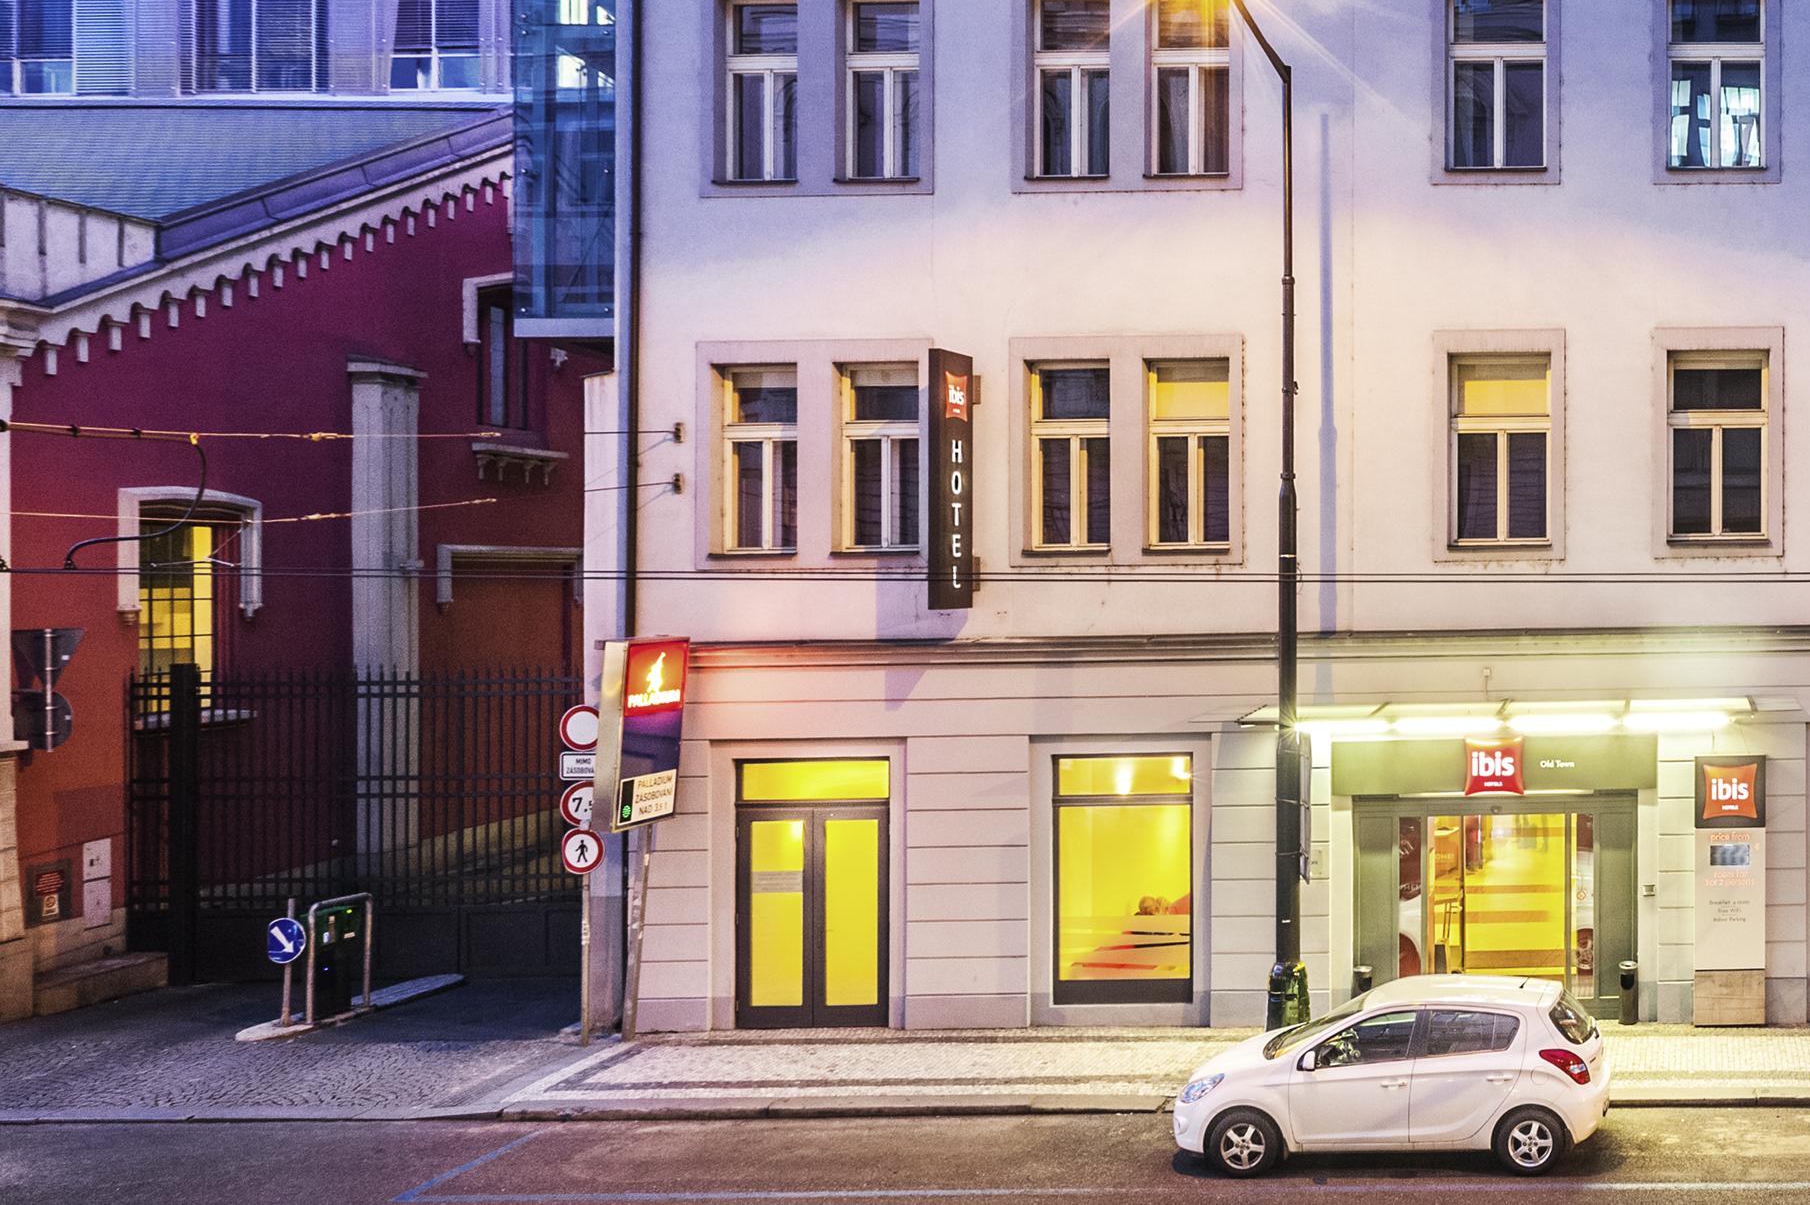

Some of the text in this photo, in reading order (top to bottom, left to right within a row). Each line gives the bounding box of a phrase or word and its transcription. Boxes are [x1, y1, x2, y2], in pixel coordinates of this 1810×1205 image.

[948, 384, 964, 406] ibis
[951, 439, 963, 589] HOTEL
[1471, 751, 1515, 777] ibis
[1539, 760, 1575, 768] Old Town
[1711, 777, 1749, 801] ibis
